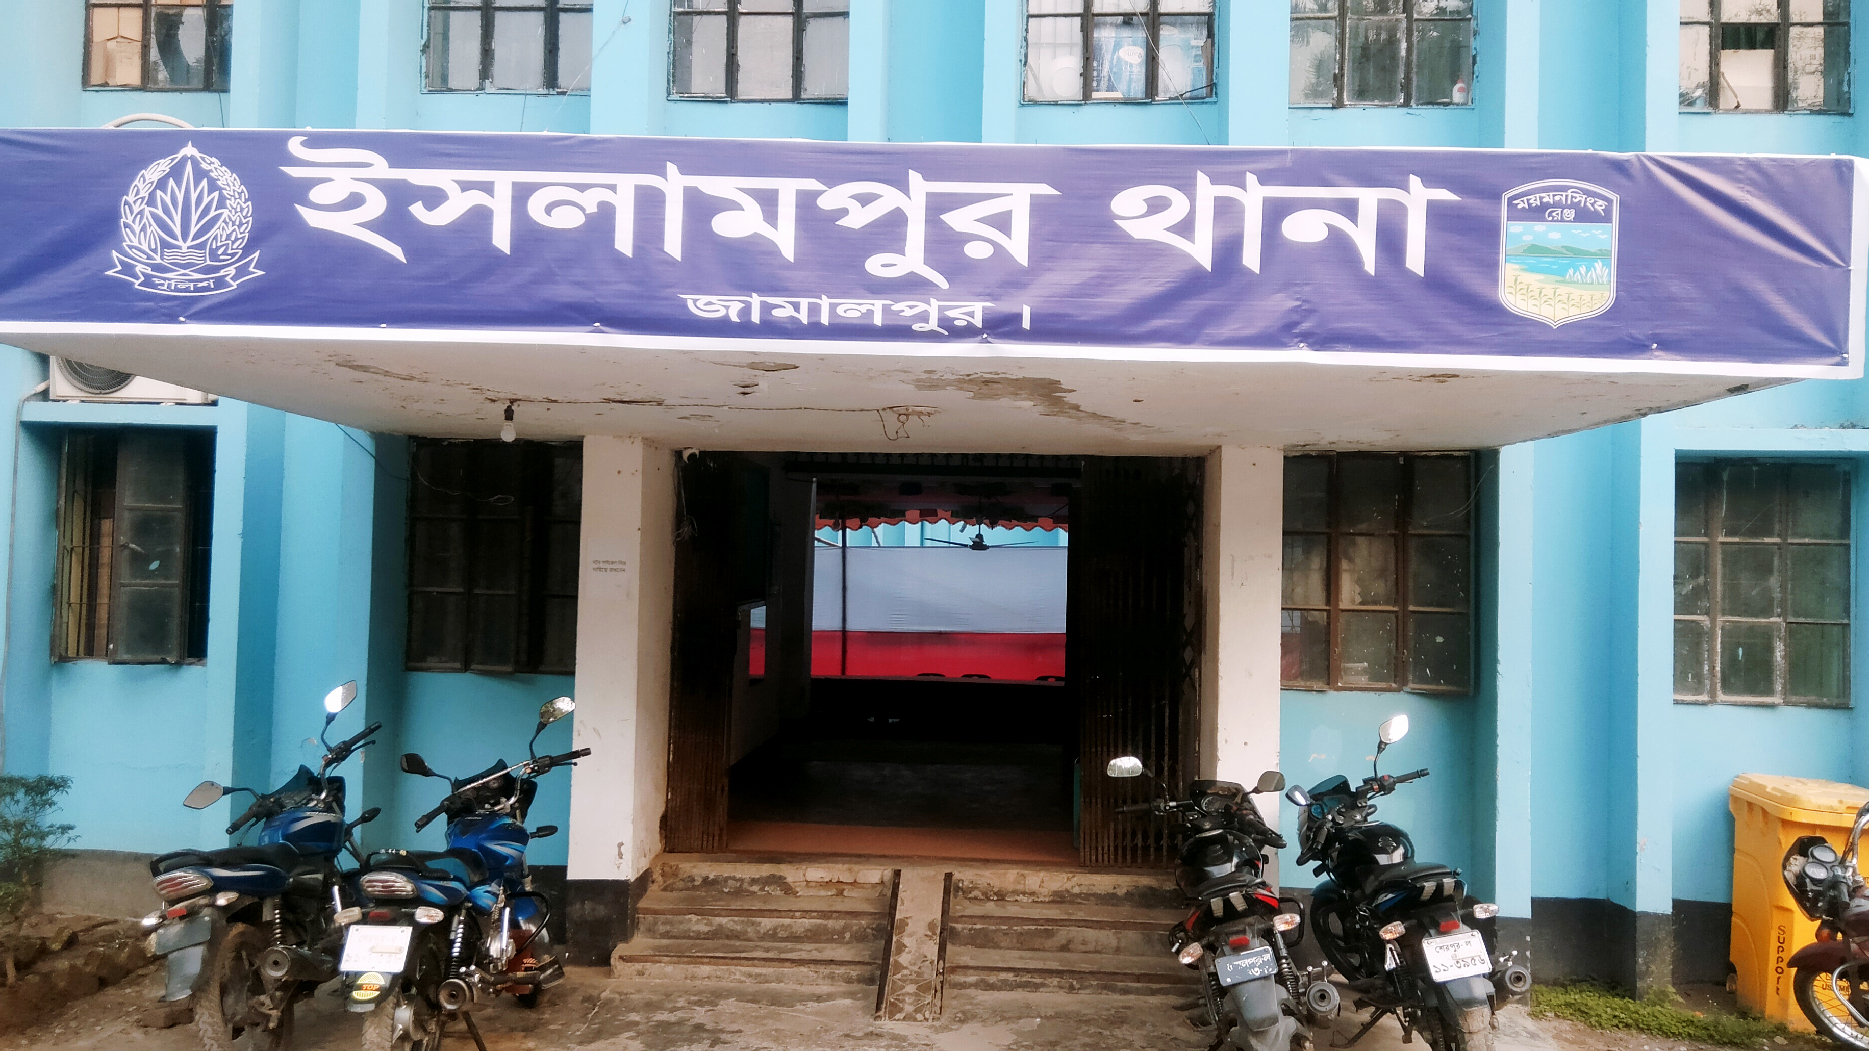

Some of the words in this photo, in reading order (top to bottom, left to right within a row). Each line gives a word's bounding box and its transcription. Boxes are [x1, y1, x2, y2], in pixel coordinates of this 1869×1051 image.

[279, 136, 1062, 289] ইসলামপুর
[1111, 170, 1461, 277] থানা
[1512, 188, 1609, 216] ময়মনসিংহ
[1545, 208, 1576, 221] রেঞ্জ
[151, 277, 215, 291] পুলিশ
[678, 292, 996, 336] জামালপুর
